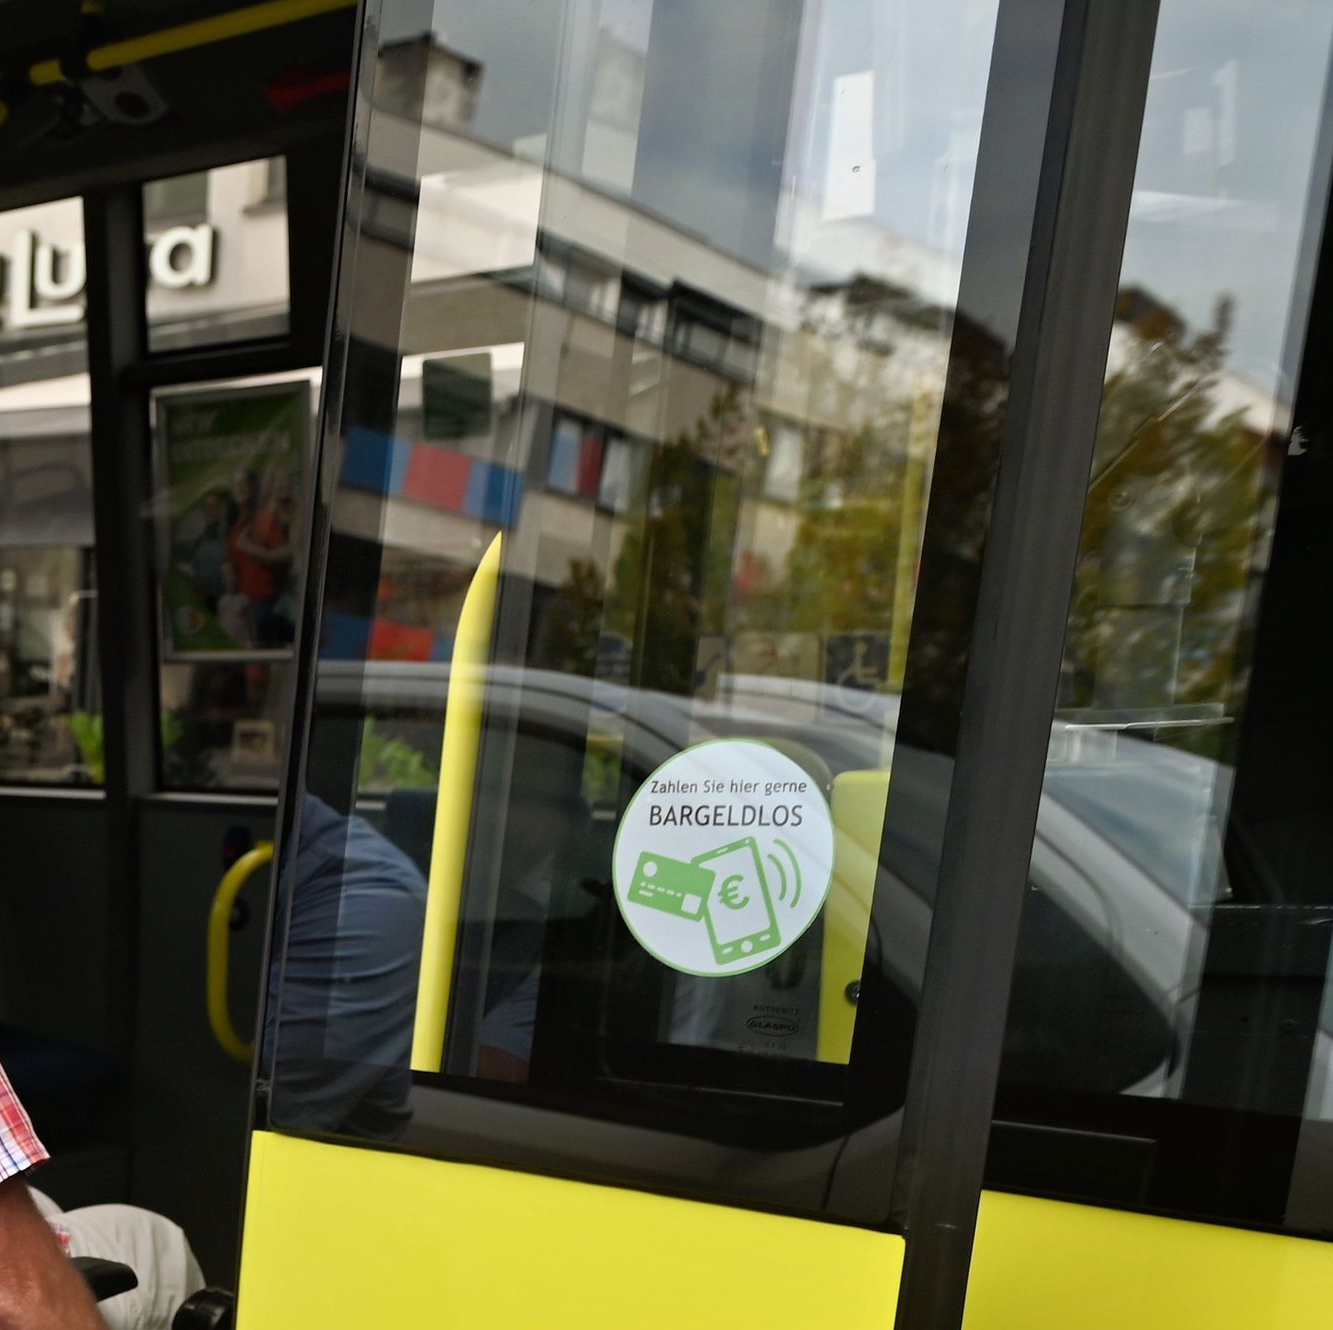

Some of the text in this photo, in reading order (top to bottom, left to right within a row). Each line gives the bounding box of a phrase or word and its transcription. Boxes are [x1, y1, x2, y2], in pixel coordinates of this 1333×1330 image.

[650, 779, 808, 796] Zahlen Sie hier gerne
[649, 804, 804, 828] BARGELDLOS
